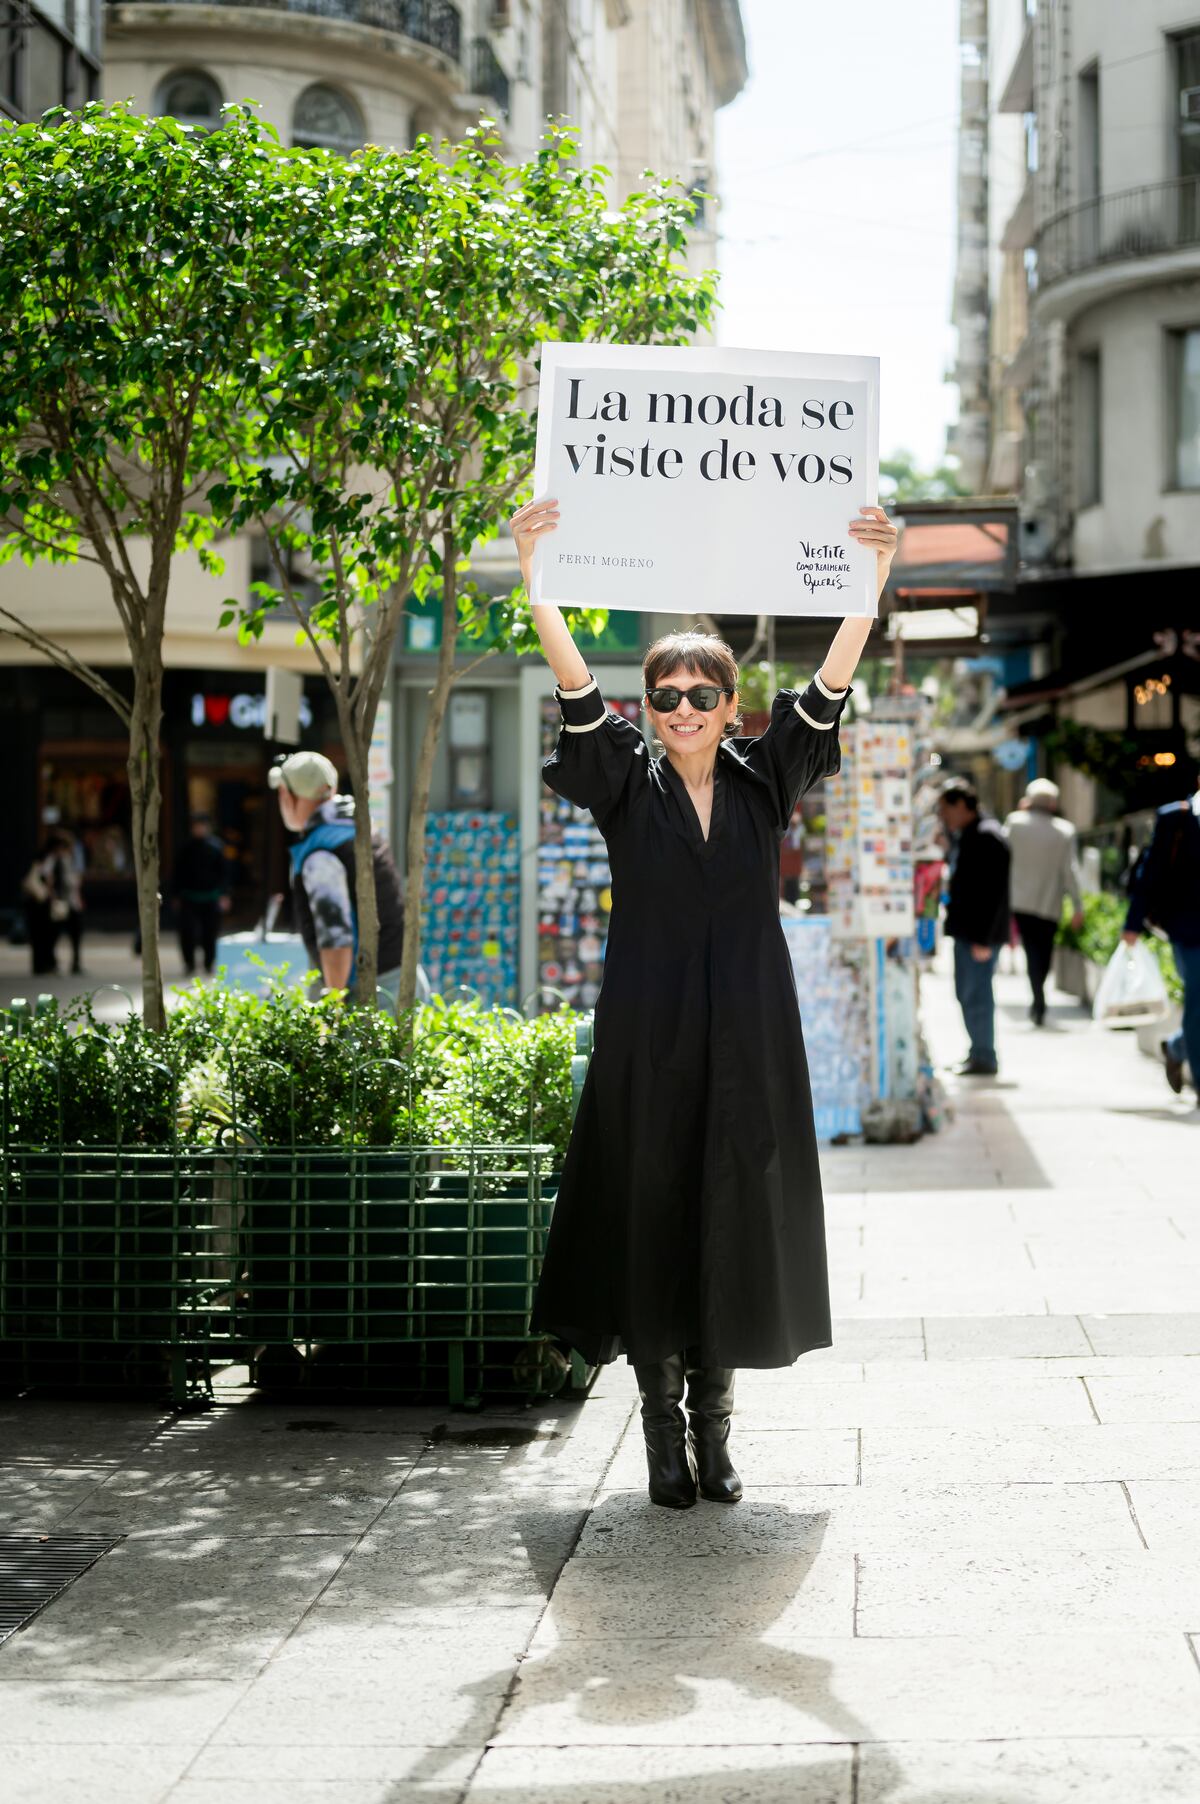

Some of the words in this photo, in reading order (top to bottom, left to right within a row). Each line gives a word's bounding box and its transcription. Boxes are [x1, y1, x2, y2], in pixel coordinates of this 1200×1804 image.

[565, 378, 630, 422] La
[647, 384, 785, 428] moda
[801, 399, 854, 431] se
[563, 433, 683, 479] viste
[699, 438, 756, 481] de
[770, 452, 853, 485] vos
[558, 554, 596, 565] FERNI
[601, 556, 654, 568] MORENO
